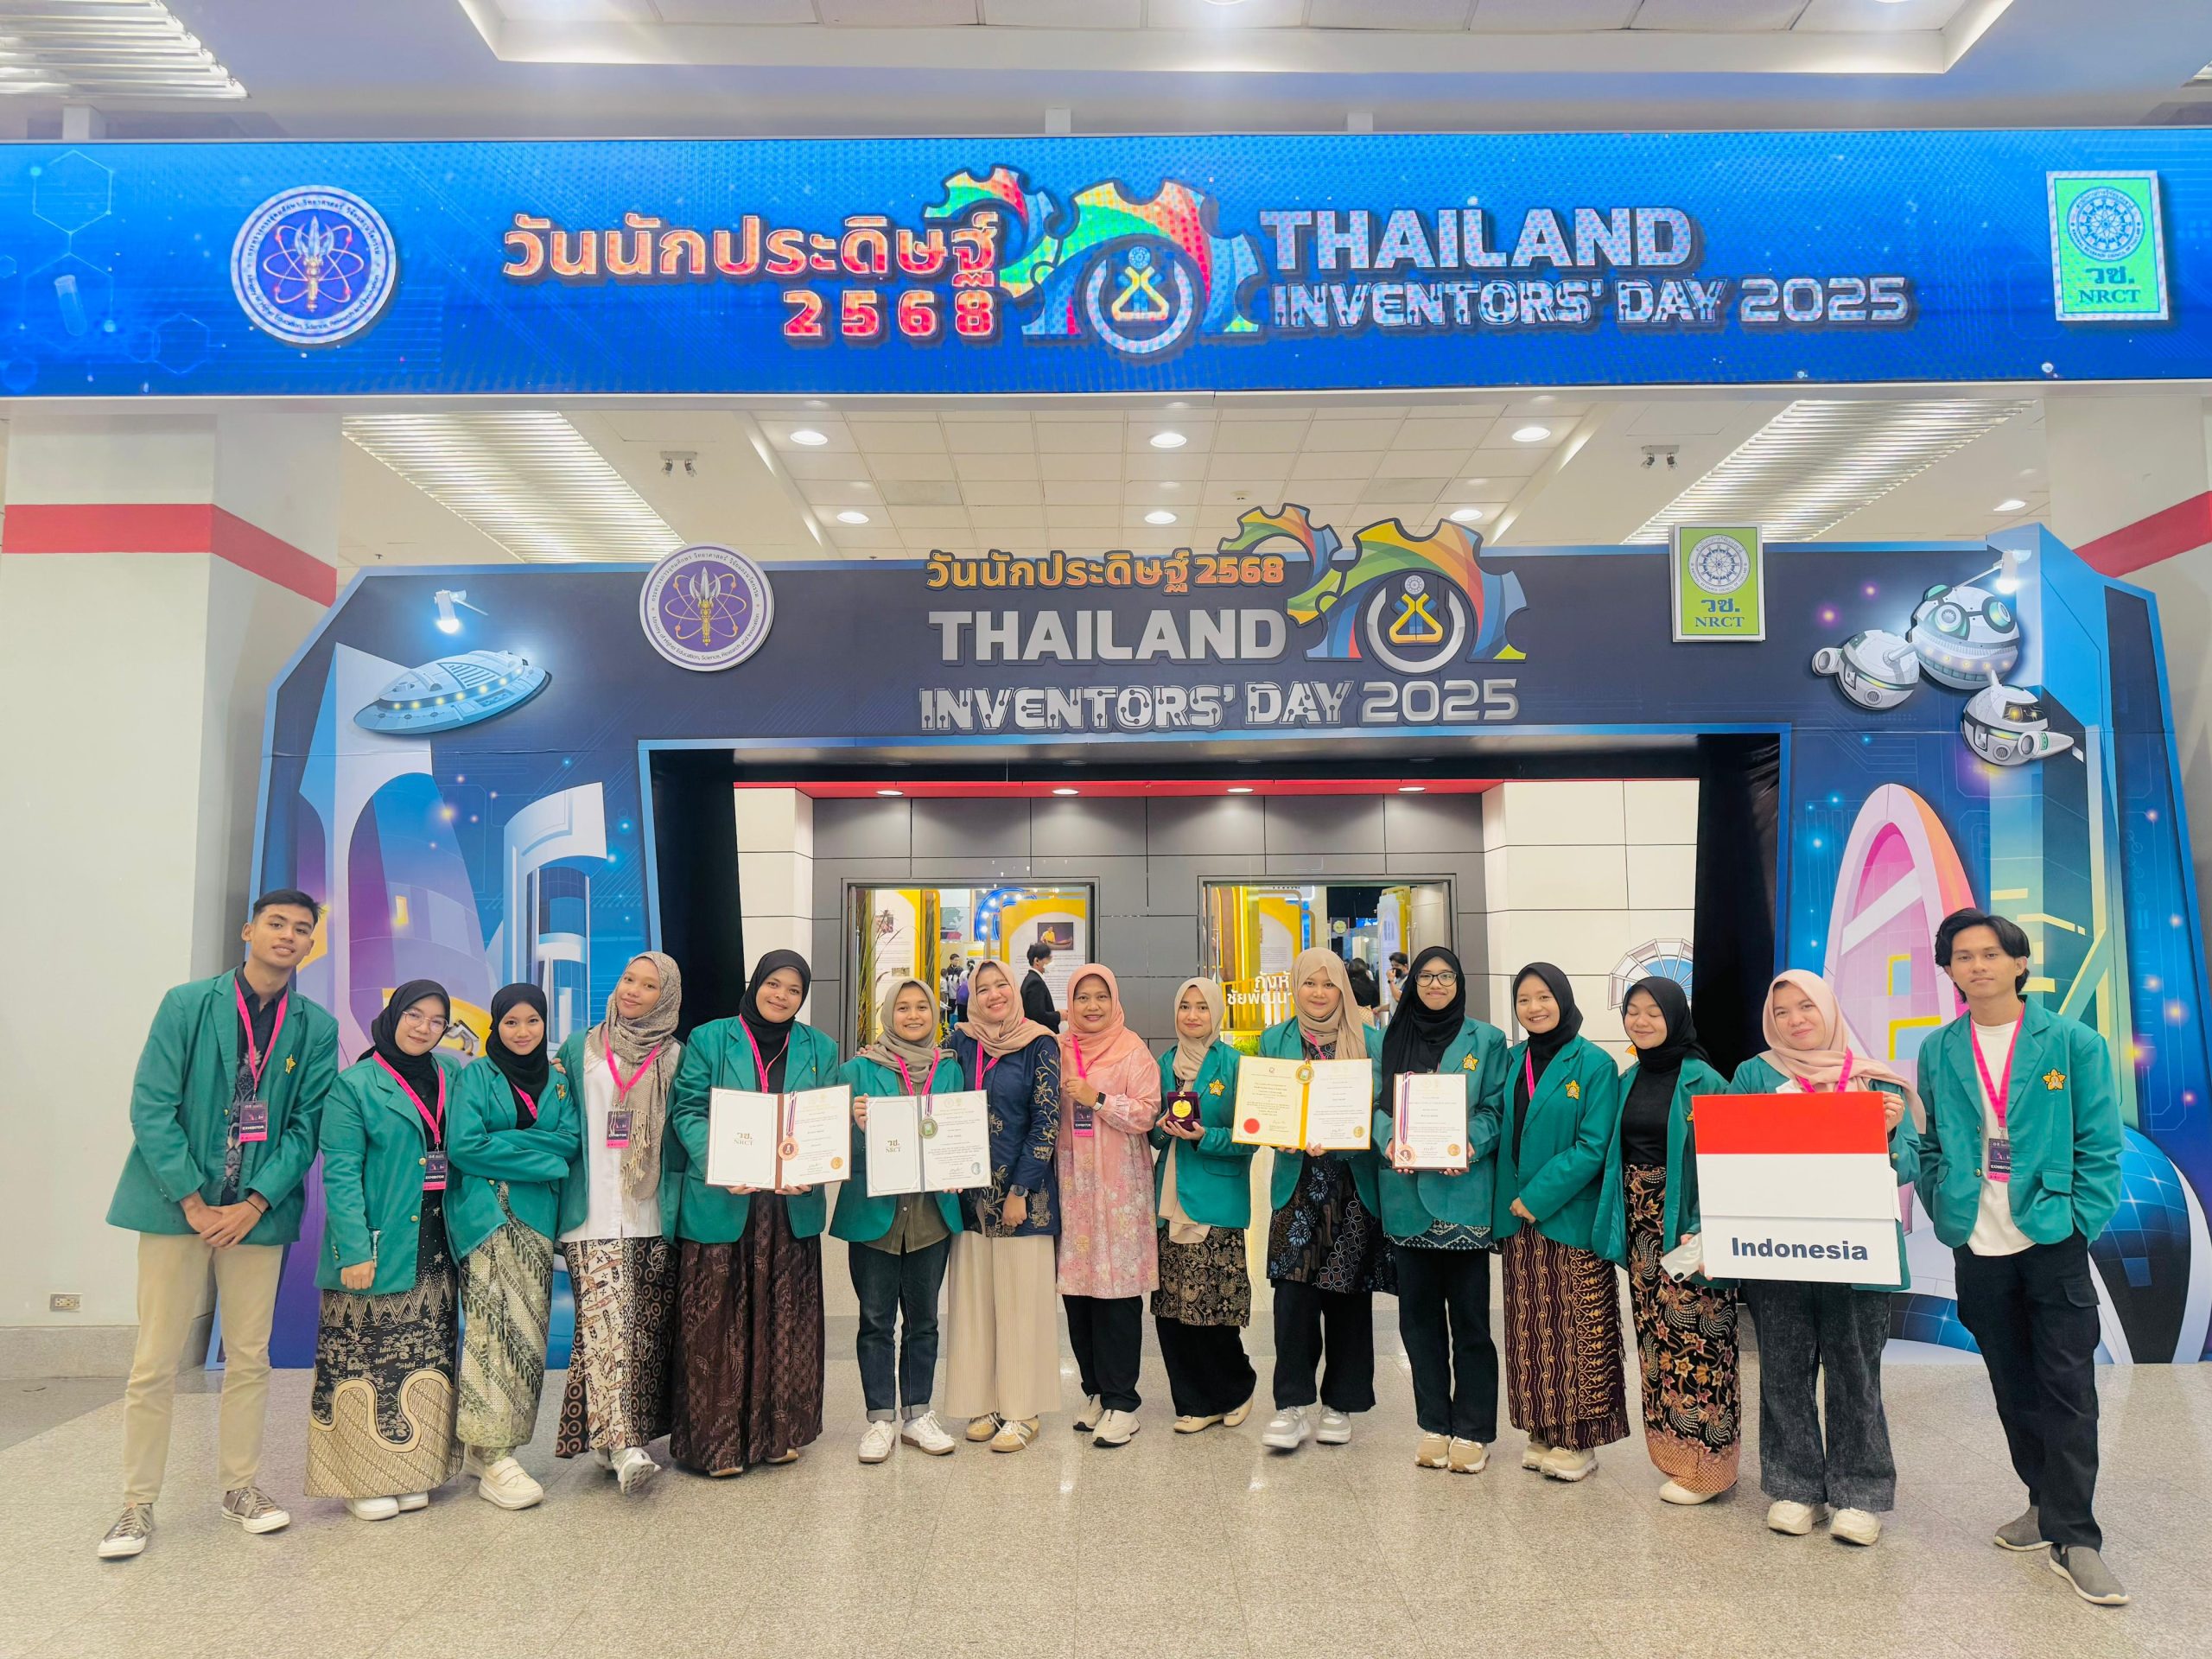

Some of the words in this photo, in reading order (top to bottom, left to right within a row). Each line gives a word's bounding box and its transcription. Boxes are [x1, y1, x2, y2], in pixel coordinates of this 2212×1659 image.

[504, 212, 999, 288] วันนักประดิษฐ์
[1260, 207, 1693, 270] THAILAND
[2085, 265, 2135, 284] วช.
[1616, 278, 1727, 325] DAY
[1738, 276, 1907, 323] 2025
[2078, 289, 2141, 303] NRCT
[925, 550, 1192, 594] วันนักประดิษฐ์
[1195, 556, 1286, 585] 2568
[1694, 616, 1745, 628] NRCT
[1700, 598, 1740, 613] วช.
[928, 608, 1287, 661] THAILAND
[1241, 680, 1354, 726] DAY
[1362, 678, 1520, 722] 2025
[1255, 970, 1291, 989] กังหั
[1732, 1237, 1868, 1261] Indonesia
